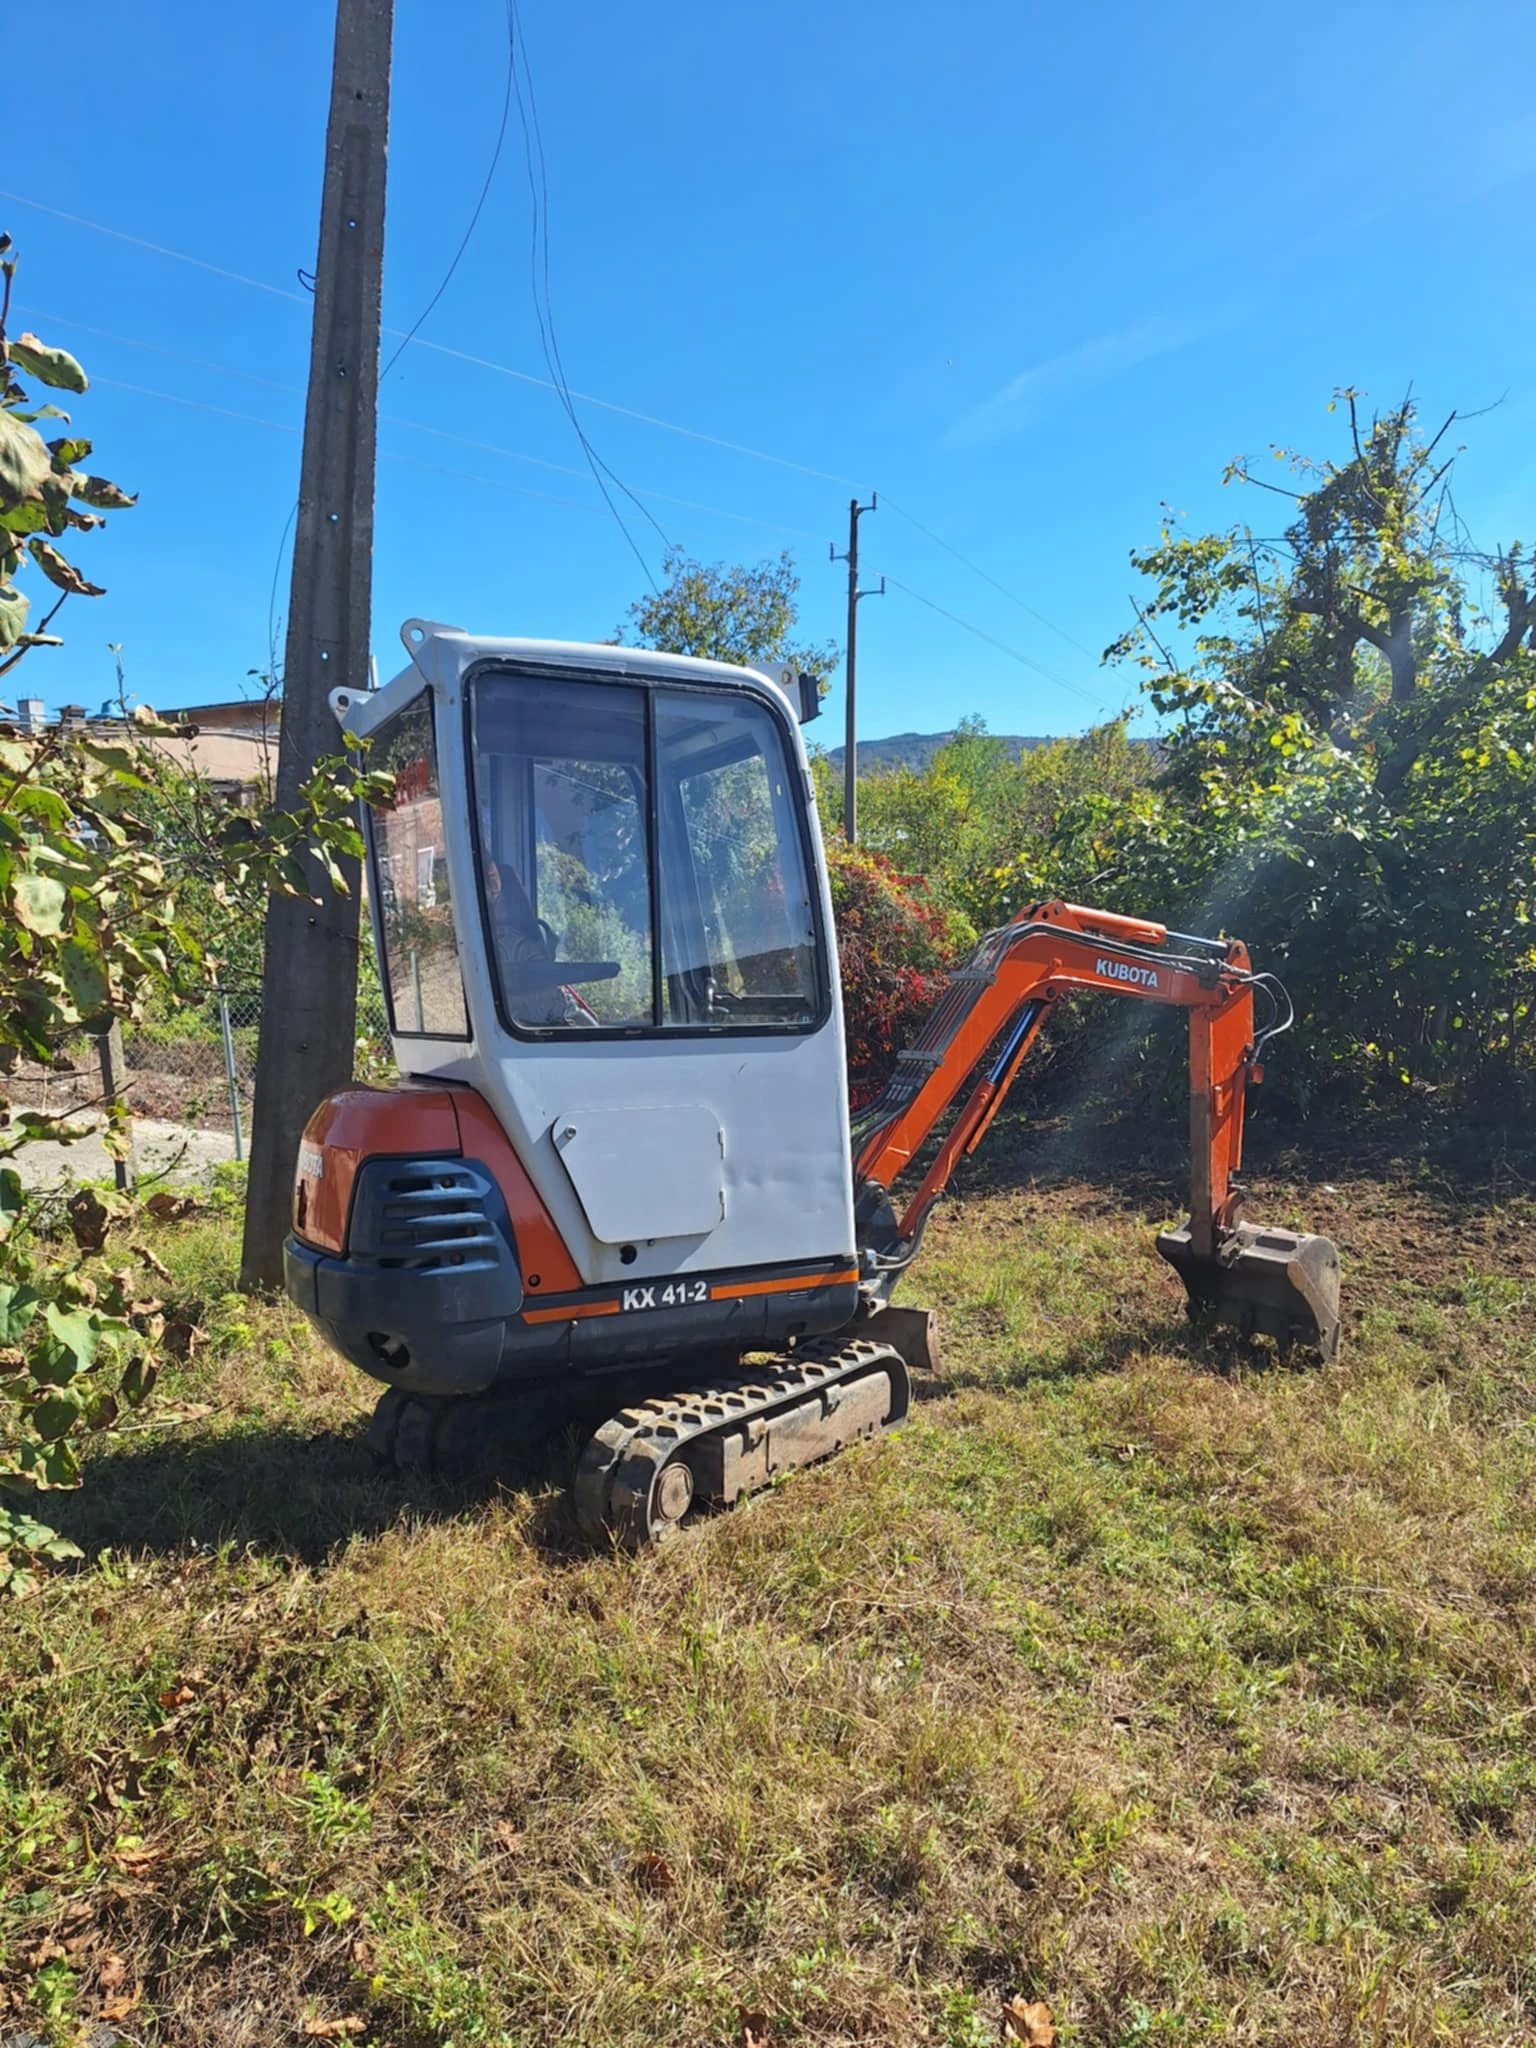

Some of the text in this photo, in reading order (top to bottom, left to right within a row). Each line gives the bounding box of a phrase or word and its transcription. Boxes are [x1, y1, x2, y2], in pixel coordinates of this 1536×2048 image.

[1096, 958, 1158, 987] KUBOTA
[623, 1281, 707, 1311] KX 41-2
